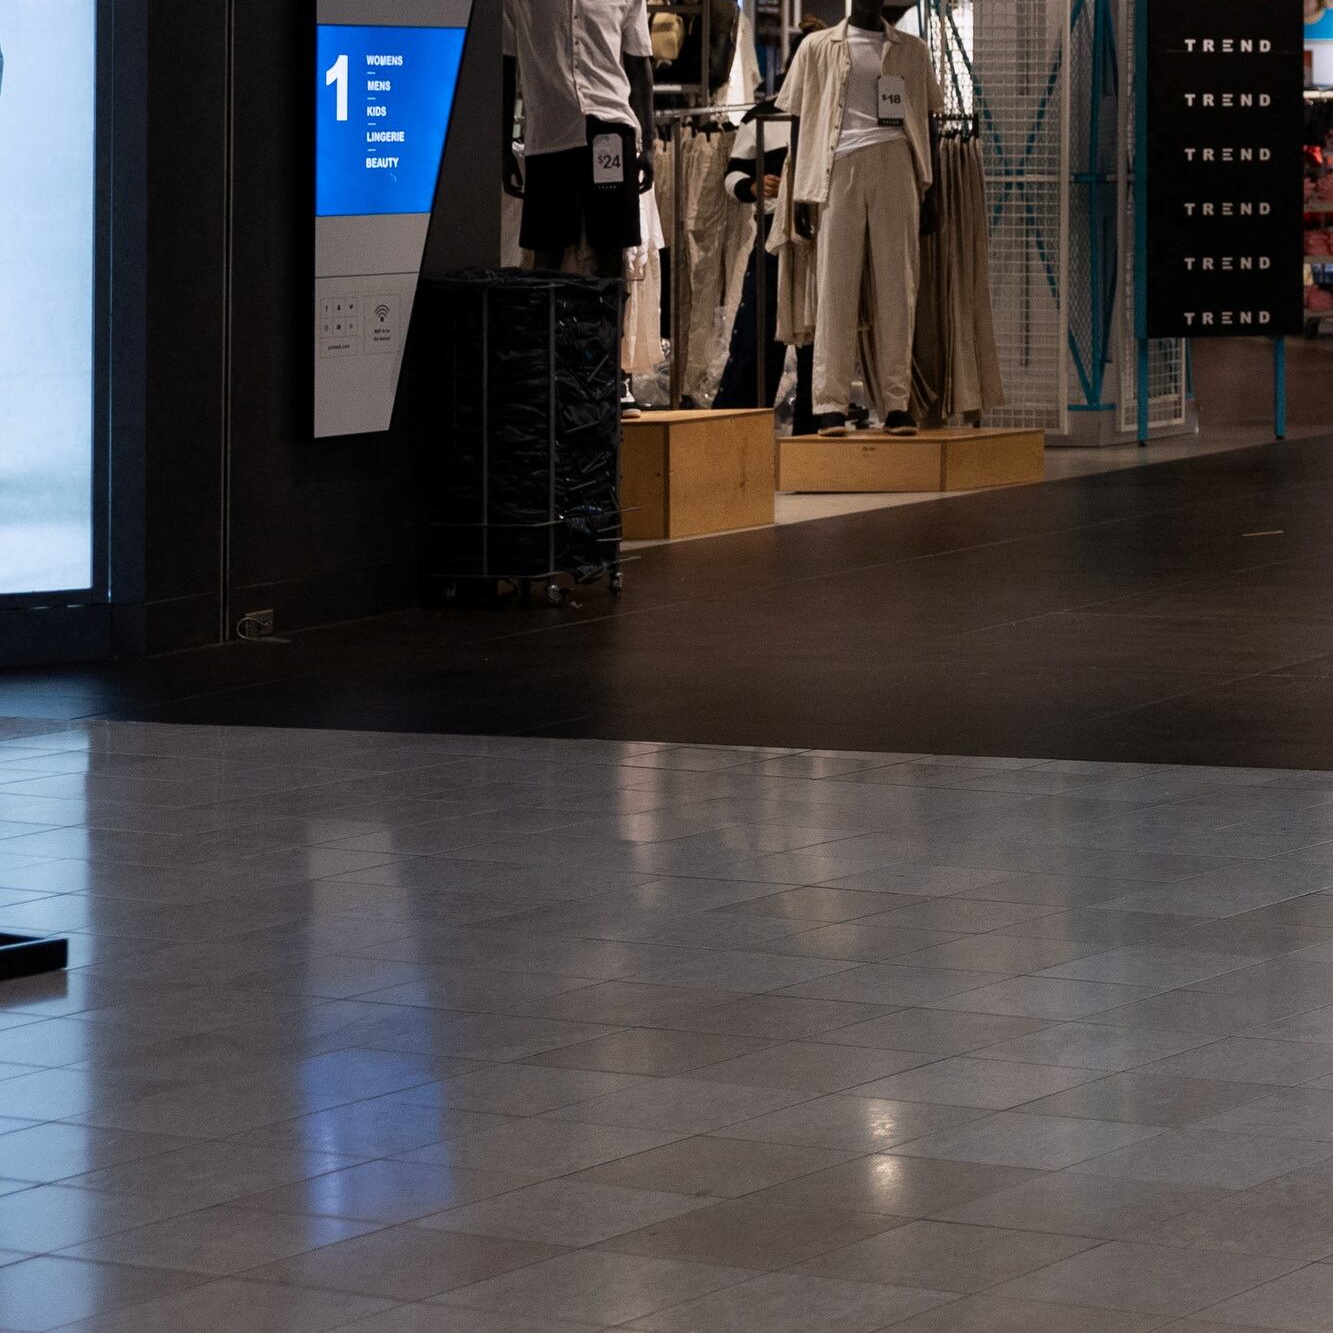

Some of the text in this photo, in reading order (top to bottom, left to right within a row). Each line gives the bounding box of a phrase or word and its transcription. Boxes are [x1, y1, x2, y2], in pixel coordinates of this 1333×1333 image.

[1184, 39, 1271, 52] TREND
[366, 55, 403, 67] WOMENS
[326, 54, 349, 121] 1
[367, 80, 391, 92] MENS
[1184, 94, 1271, 107] TREND
[366, 106, 387, 117] KIDS
[366, 131, 405, 142] LINGERIE
[1184, 148, 1271, 161] TREND
[365, 157, 399, 169] BEAUTY
[598, 154, 621, 169] $24
[1184, 203, 1271, 216] TREND
[1184, 257, 1271, 270] TREND
[1184, 311, 1271, 325] TREND
